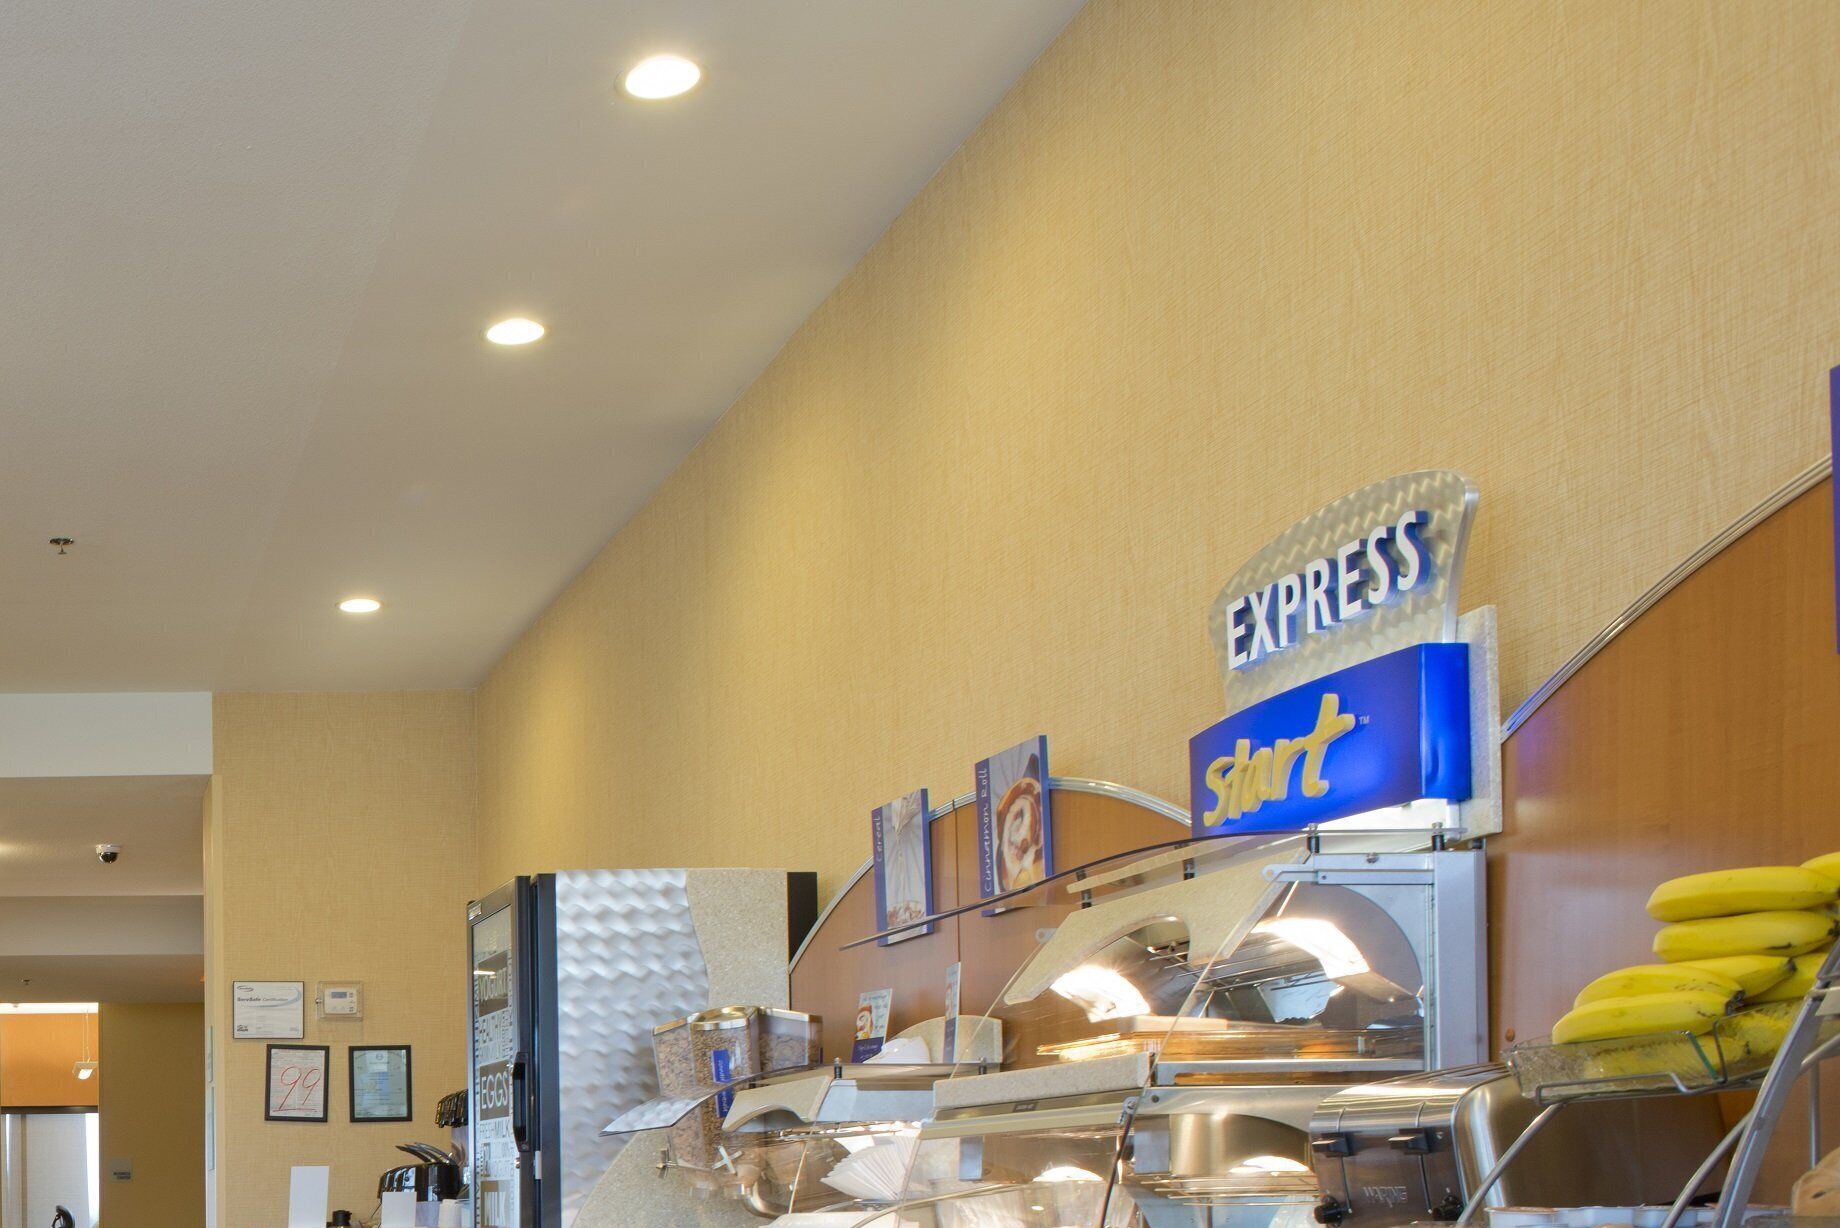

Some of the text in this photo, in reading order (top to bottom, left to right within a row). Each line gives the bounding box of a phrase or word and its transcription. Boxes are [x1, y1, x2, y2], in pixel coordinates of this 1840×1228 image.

[1225, 509, 1431, 671] EXPRESS
[873, 815, 882, 862] Cereal
[978, 767, 992, 892] Cinnamon Roll
[279, 1066, 321, 1111] 99
[481, 1071, 508, 1109] EGGS
[483, 1191, 506, 1227] MILK
